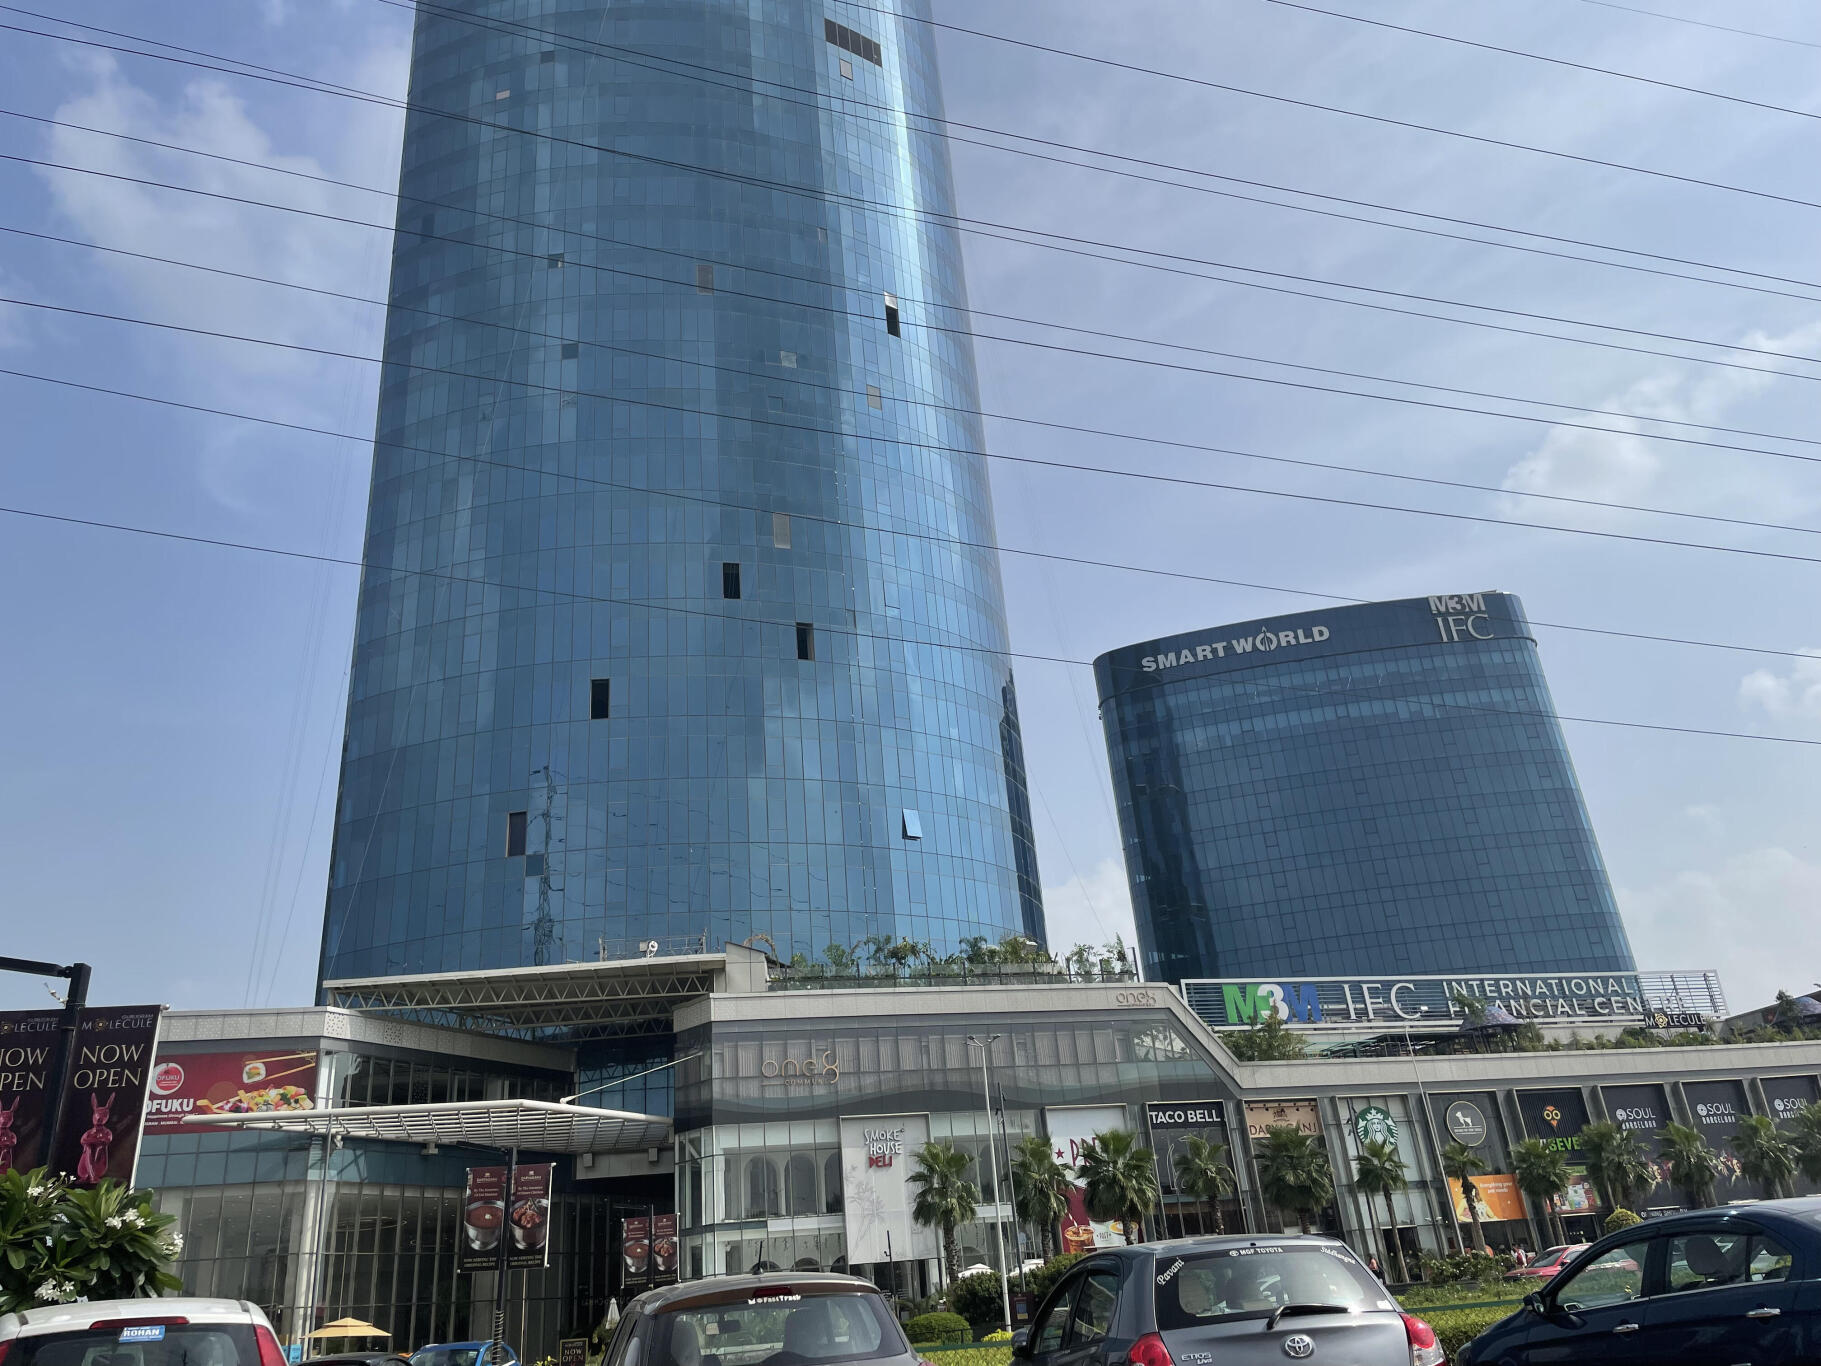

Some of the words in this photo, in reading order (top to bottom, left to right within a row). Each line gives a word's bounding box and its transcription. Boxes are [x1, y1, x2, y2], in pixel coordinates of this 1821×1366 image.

[1428, 594, 1487, 614] M3M
[1436, 613, 1495, 643] IFC
[1142, 641, 1228, 673] SMART
[1231, 624, 1331, 656] WORLD
[1442, 977, 1634, 998] INTERNATIONAL
[1222, 983, 1323, 1024] M3M
[1340, 982, 1422, 1020] IFC
[1448, 996, 1587, 1018] FIANCIAL
[1592, 994, 1693, 1014] CENTRE
[79, 1043, 145, 1065] NOW
[0, 1071, 47, 1092] PEN
[74, 1067, 142, 1089] OPEN
[1149, 1110, 1185, 1125] TACO
[1187, 1109, 1221, 1123] BELL
[1627, 1107, 1656, 1120] SOUL
[1707, 1103, 1735, 1115] SOUL
[863, 1128, 903, 1145] SMOKE
[869, 1142, 903, 1156] HOUSE
[868, 1154, 893, 1169] DELI
[1156, 1256, 1185, 1287] Pavani
[122, 1328, 160, 1337] ROHAN
[1181, 1352, 1212, 1361] ETIOS
